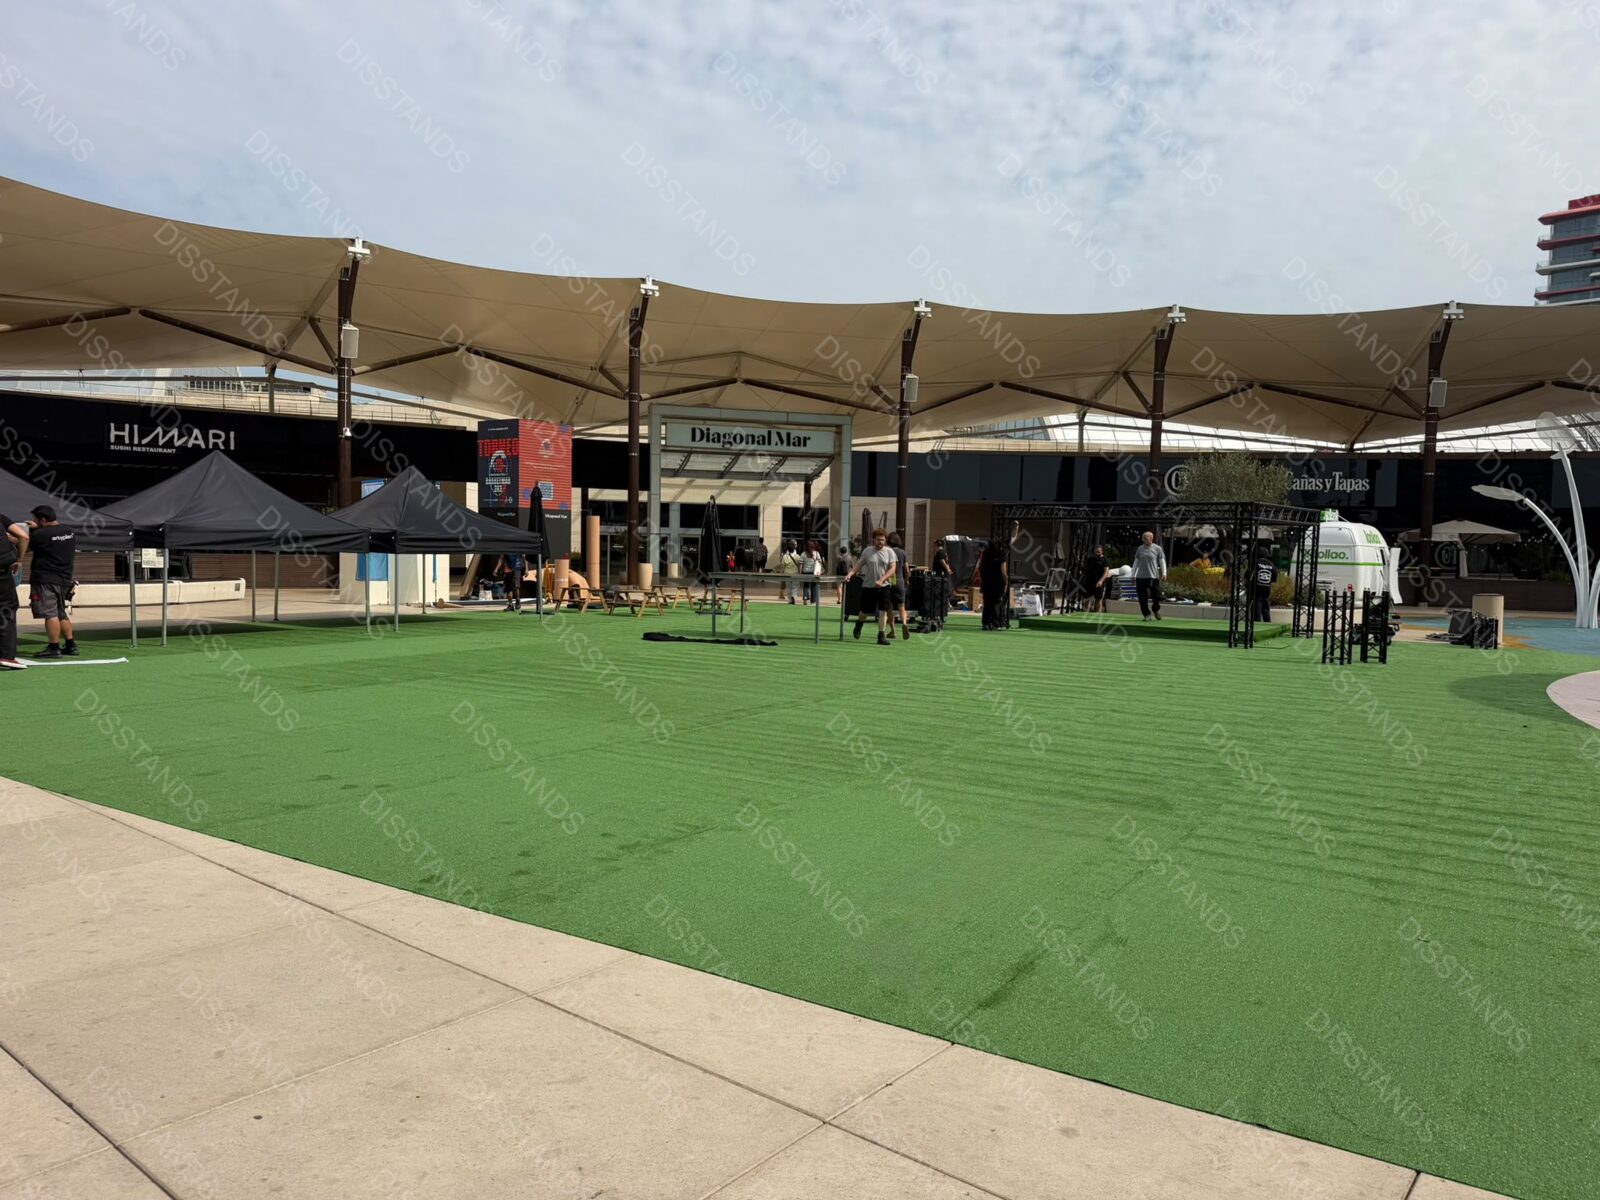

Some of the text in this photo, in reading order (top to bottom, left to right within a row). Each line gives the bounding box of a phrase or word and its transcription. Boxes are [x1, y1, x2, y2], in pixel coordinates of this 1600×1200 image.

[109, 422, 235, 450] HIMARI
[691, 426, 811, 449] Diagonal Mar
[132, 445, 177, 454] RESTAURANT
[1323, 477, 1332, 492] y
[1332, 471, 1370, 493] Tapas
